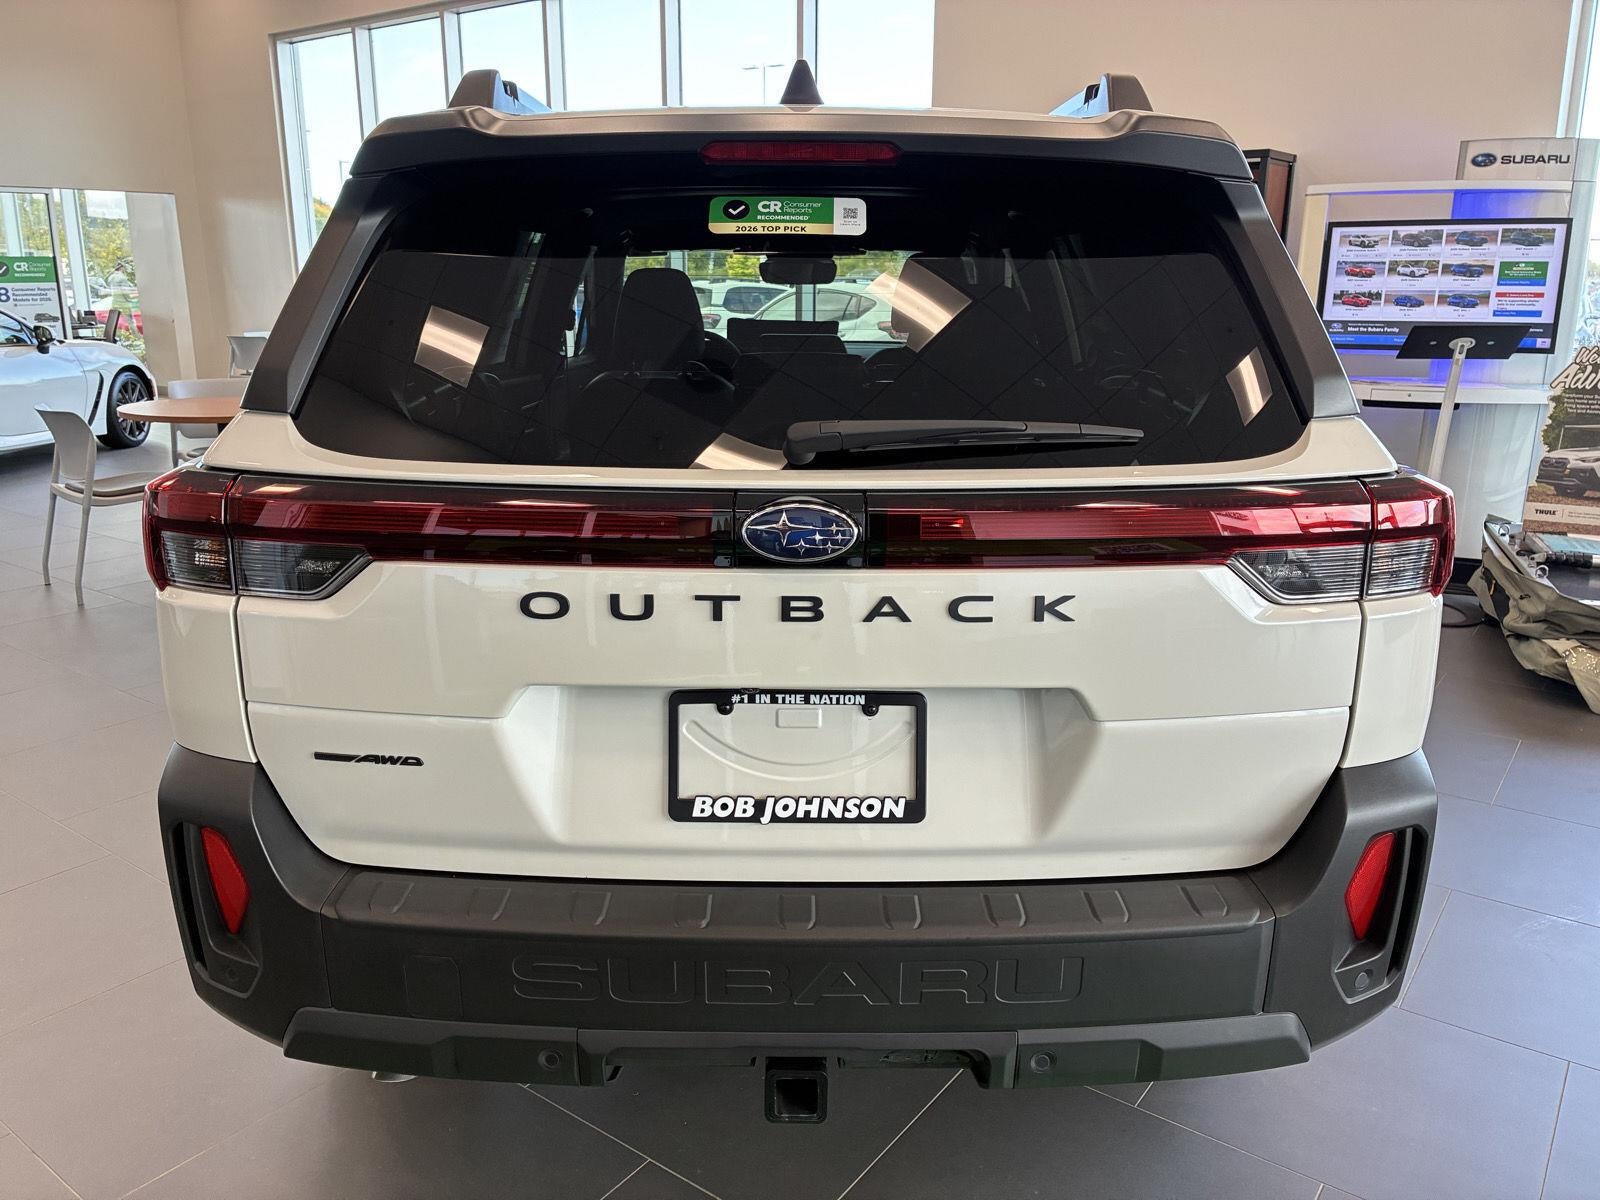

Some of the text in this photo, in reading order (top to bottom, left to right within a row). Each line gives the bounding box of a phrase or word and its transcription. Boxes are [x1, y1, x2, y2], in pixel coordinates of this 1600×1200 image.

[1500, 154, 1571, 165] SUBARU
[757, 200, 782, 213] CR
[783, 225, 807, 233] PICK
[13, 262, 29, 271] CR
[1575, 346, 1600, 365] We
[1534, 508, 1557, 516] THULE
[519, 591, 1076, 623] OUTBACK
[731, 694, 866, 705] #1 IN THE NATION
[354, 754, 424, 767] AWD
[691, 796, 906, 825] BOB JOHNSON
[512, 956, 1084, 1006] SUBARU
